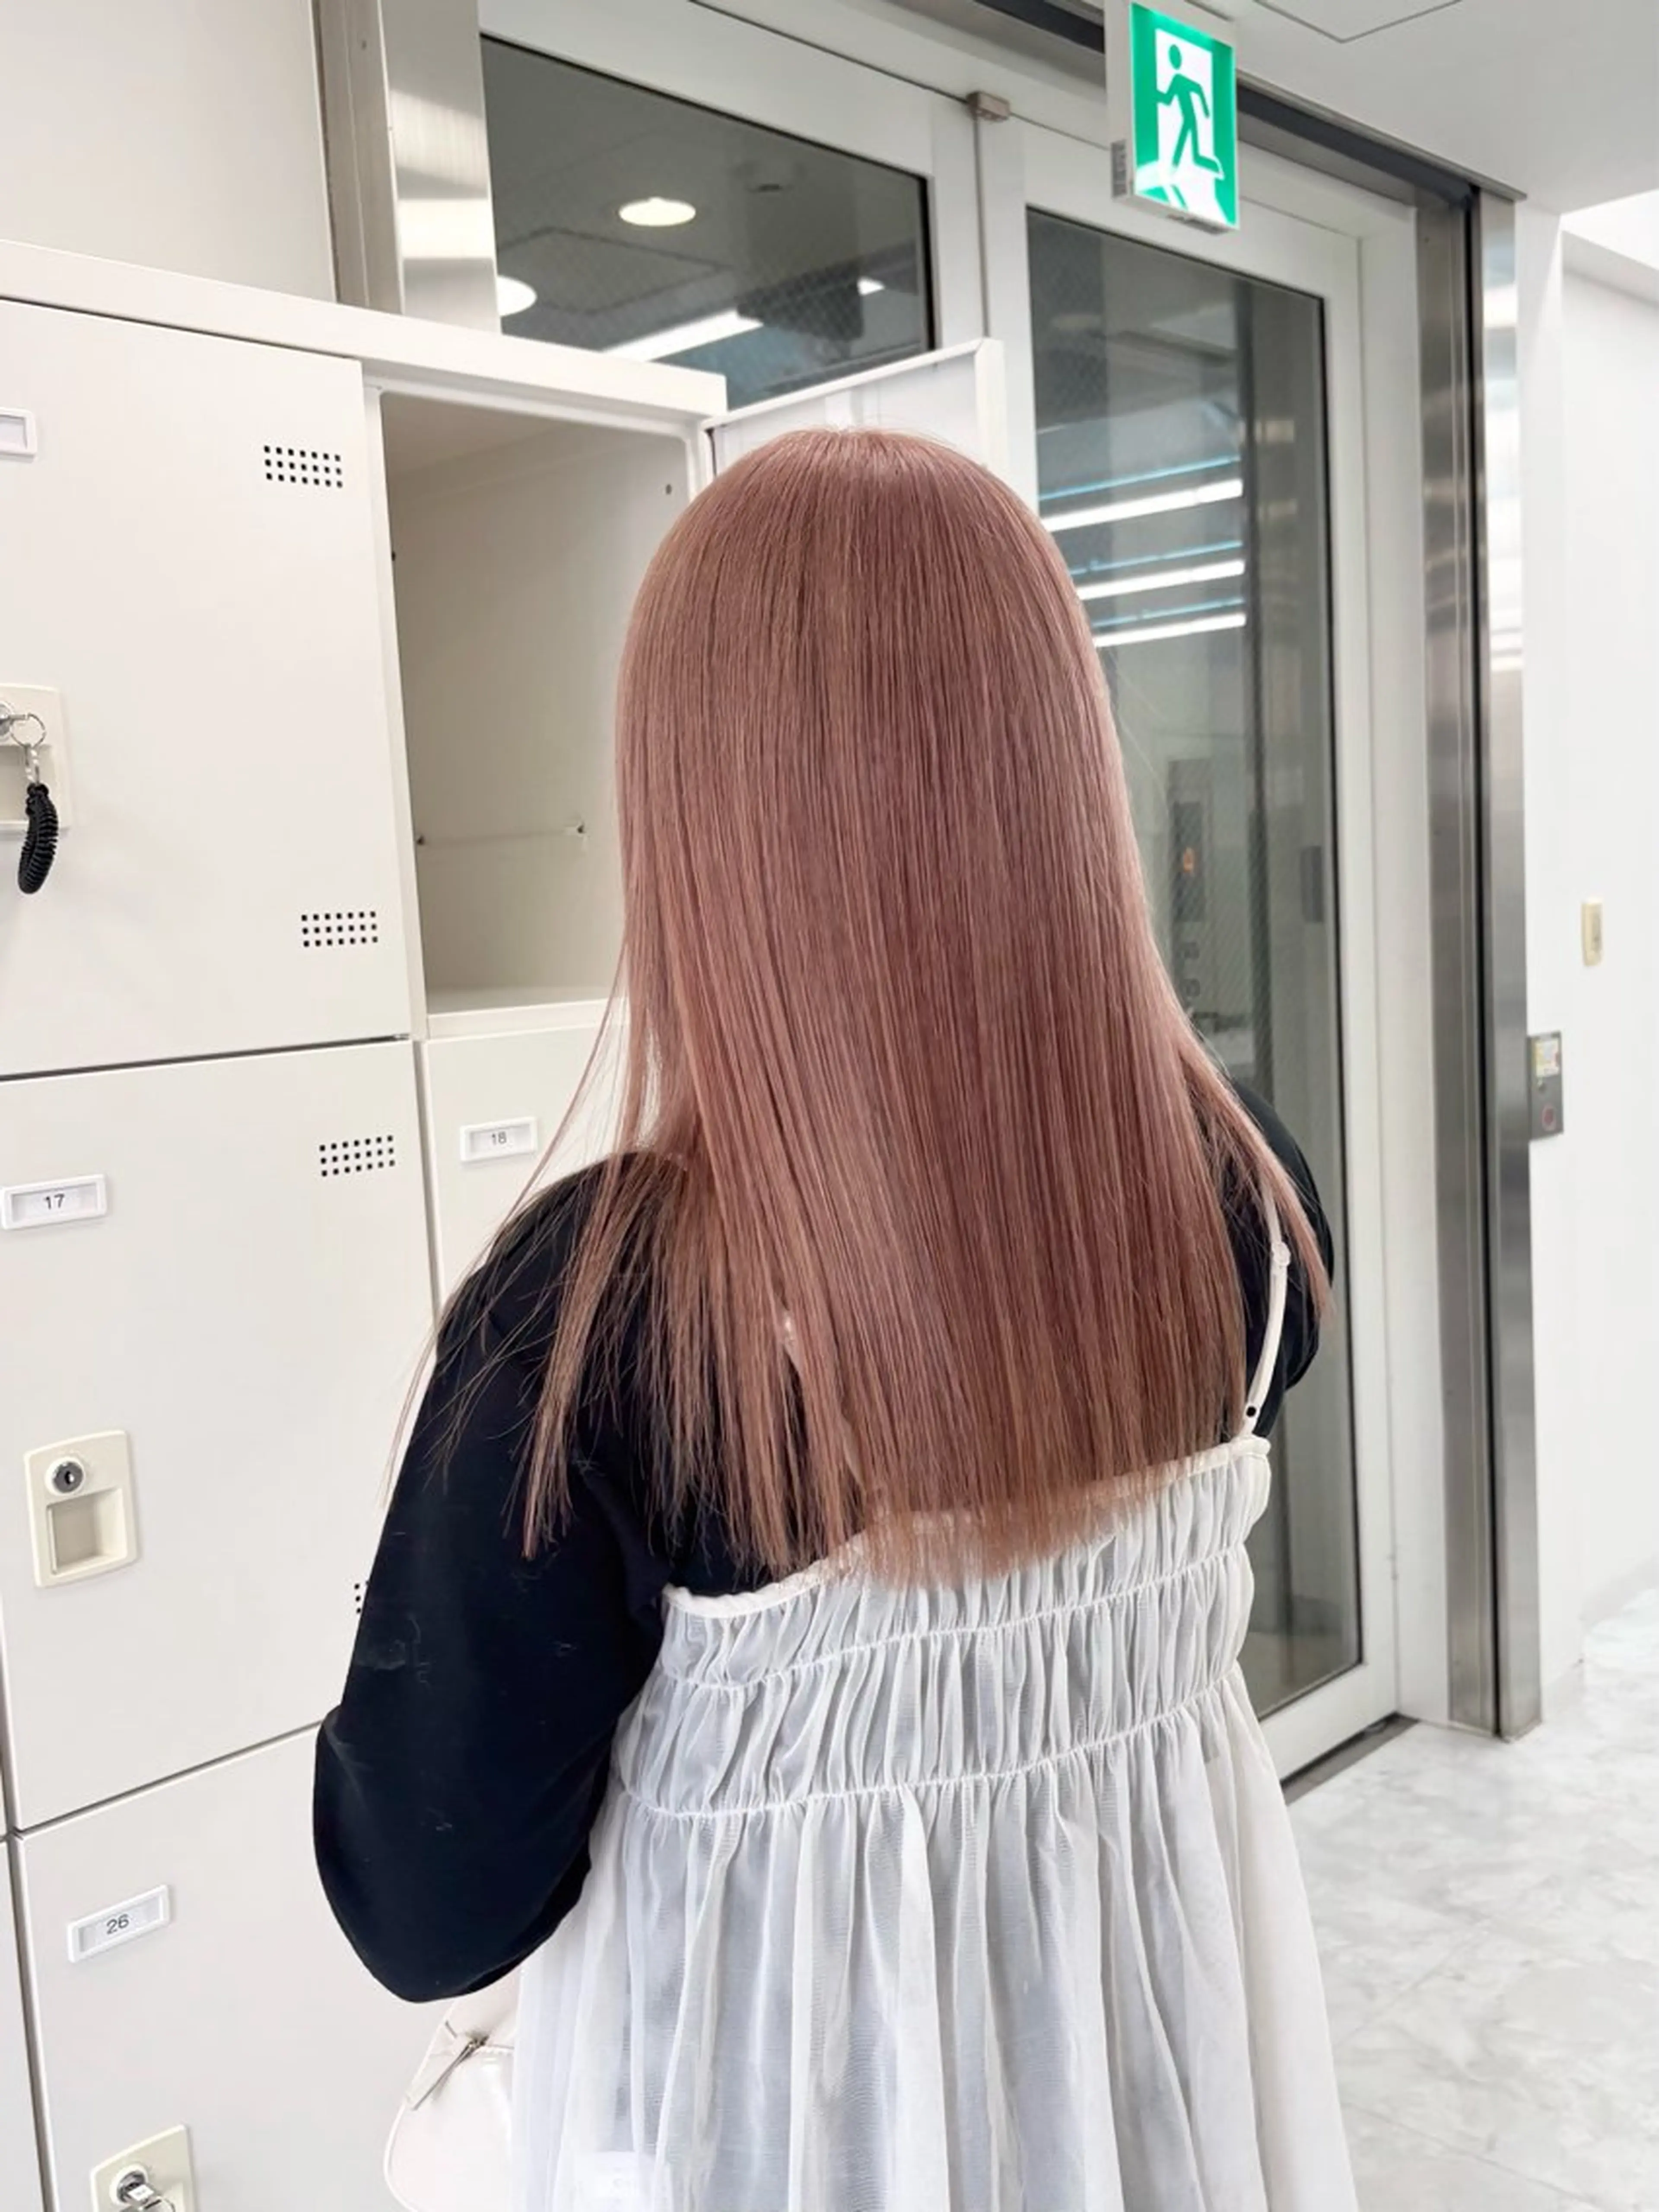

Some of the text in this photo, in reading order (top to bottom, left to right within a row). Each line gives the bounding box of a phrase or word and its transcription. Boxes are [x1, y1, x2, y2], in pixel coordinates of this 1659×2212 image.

[491, 1131, 507, 1145] 18
[44, 1193, 64, 1210] 17
[106, 1913, 129, 1935] 26
